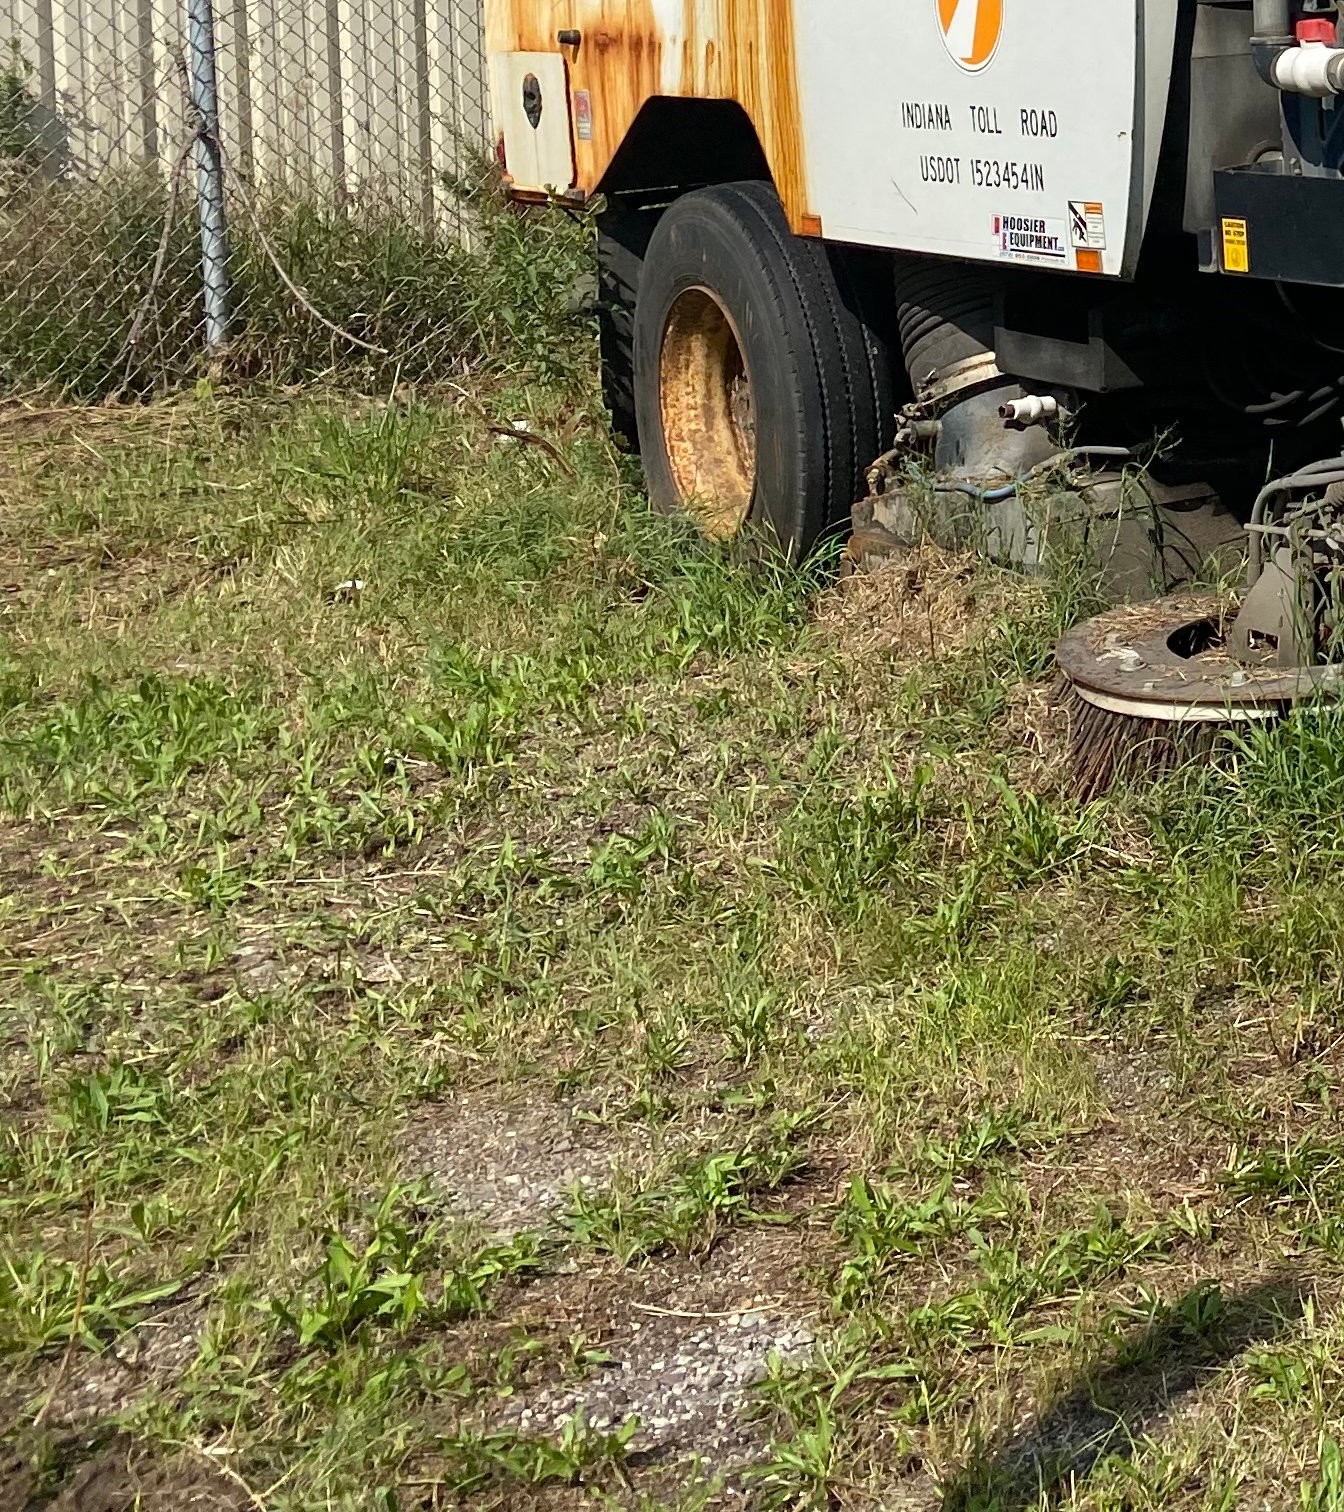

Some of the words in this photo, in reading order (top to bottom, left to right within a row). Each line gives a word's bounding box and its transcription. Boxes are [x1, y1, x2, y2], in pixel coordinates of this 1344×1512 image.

[901, 101, 952, 131] INDIANA
[969, 105, 1002, 134] TOLL
[1020, 108, 1058, 138] ROAD
[920, 154, 960, 185] USDOT
[1003, 216, 1045, 234] HOOSIER
[1010, 232, 1058, 251] EQUIPMENT
